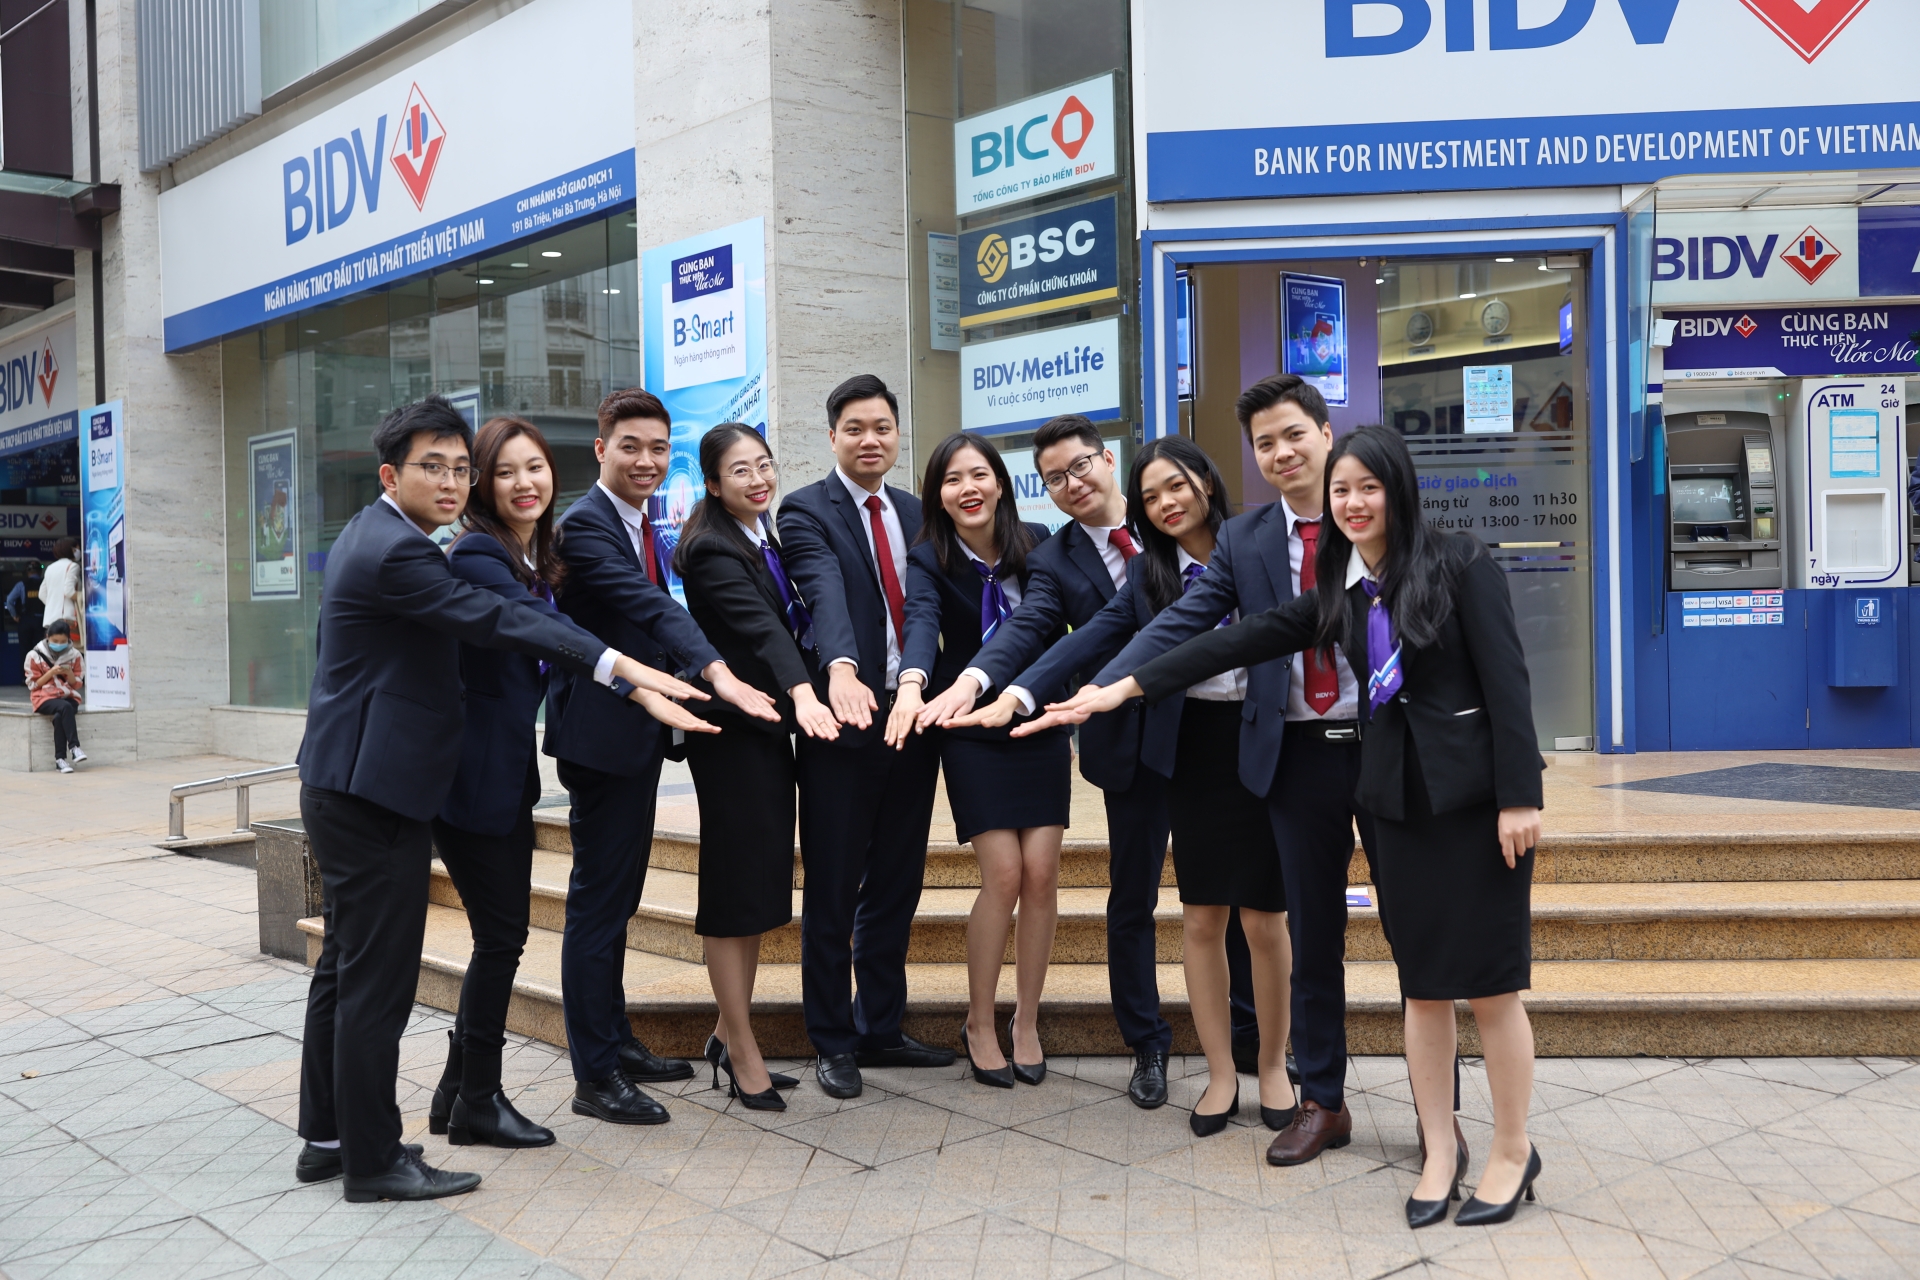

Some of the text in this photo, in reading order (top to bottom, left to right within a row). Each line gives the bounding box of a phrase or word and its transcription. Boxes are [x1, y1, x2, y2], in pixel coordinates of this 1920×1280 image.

[971, 114, 1049, 177] BIC
[1254, 145, 1320, 176] BANK
[1326, 144, 1372, 173] FOR
[1378, 138, 1530, 171] INVESTMENT
[1536, 136, 1588, 166] AND
[1595, 128, 1773, 164] DEVELOPMENT
[1779, 127, 1810, 156] OF
[283, 113, 387, 246] BIDV
[996, 184, 1019, 197] CÔNG
[1021, 180, 1031, 190] TY
[1033, 173, 1051, 187] BẢO
[1075, 162, 1096, 176] BIDV
[516, 168, 613, 213] CHI NHÁNH SỞ GIAO DỊCH 1
[512, 184, 622, 234] 191 Bà Triệu, Hai Bà Trưng, Hà Nội
[1010, 220, 1096, 270] BSC
[264, 218, 485, 312] NGÂN HÀNG TMCP ĐẦU TƯ VÀ PHÁT TRIỂN VIỆT NAM
[678, 256, 714, 276] CÙNG BẠN
[1646, 234, 1779, 282] BIDV
[977, 268, 1098, 306] CÔNG TY CỔ PHẦN CHỨNG KHOÁN
[673, 310, 734, 347] B-Smart
[1680, 317, 1733, 337] BIDV
[1780, 311, 1888, 333] CÙNG BẠN
[1781, 334, 1818, 348] THỰC
[674, 344, 736, 367] Ngân hàng thông minh
[0, 351, 37, 414] BIDV
[1881, 384, 1895, 394] 24
[987, 382, 1089, 408] Vì cuộc sống trọn vẹn
[1817, 394, 1854, 407] ATM
[1881, 398, 1900, 408] Giờ
[61, 475, 76, 483] VISA
[1416, 473, 1517, 492] Giờ giao dịch
[1417, 492, 1577, 511] áng từ 8:00 11 h30
[0, 513, 39, 529] BIDV
[1458, 515, 1474, 528] từ
[1481, 515, 1520, 528] 13:00
[1533, 514, 1546, 526] 17
[1550, 513, 1577, 526] h00
[4, 540, 23, 548] BIDV
[307, 552, 326, 572] BID
[1810, 559, 1817, 568] 7
[1811, 573, 1840, 587] ngày
[106, 665, 119, 679] BIDV
[1315, 691, 1329, 699] BIDV
